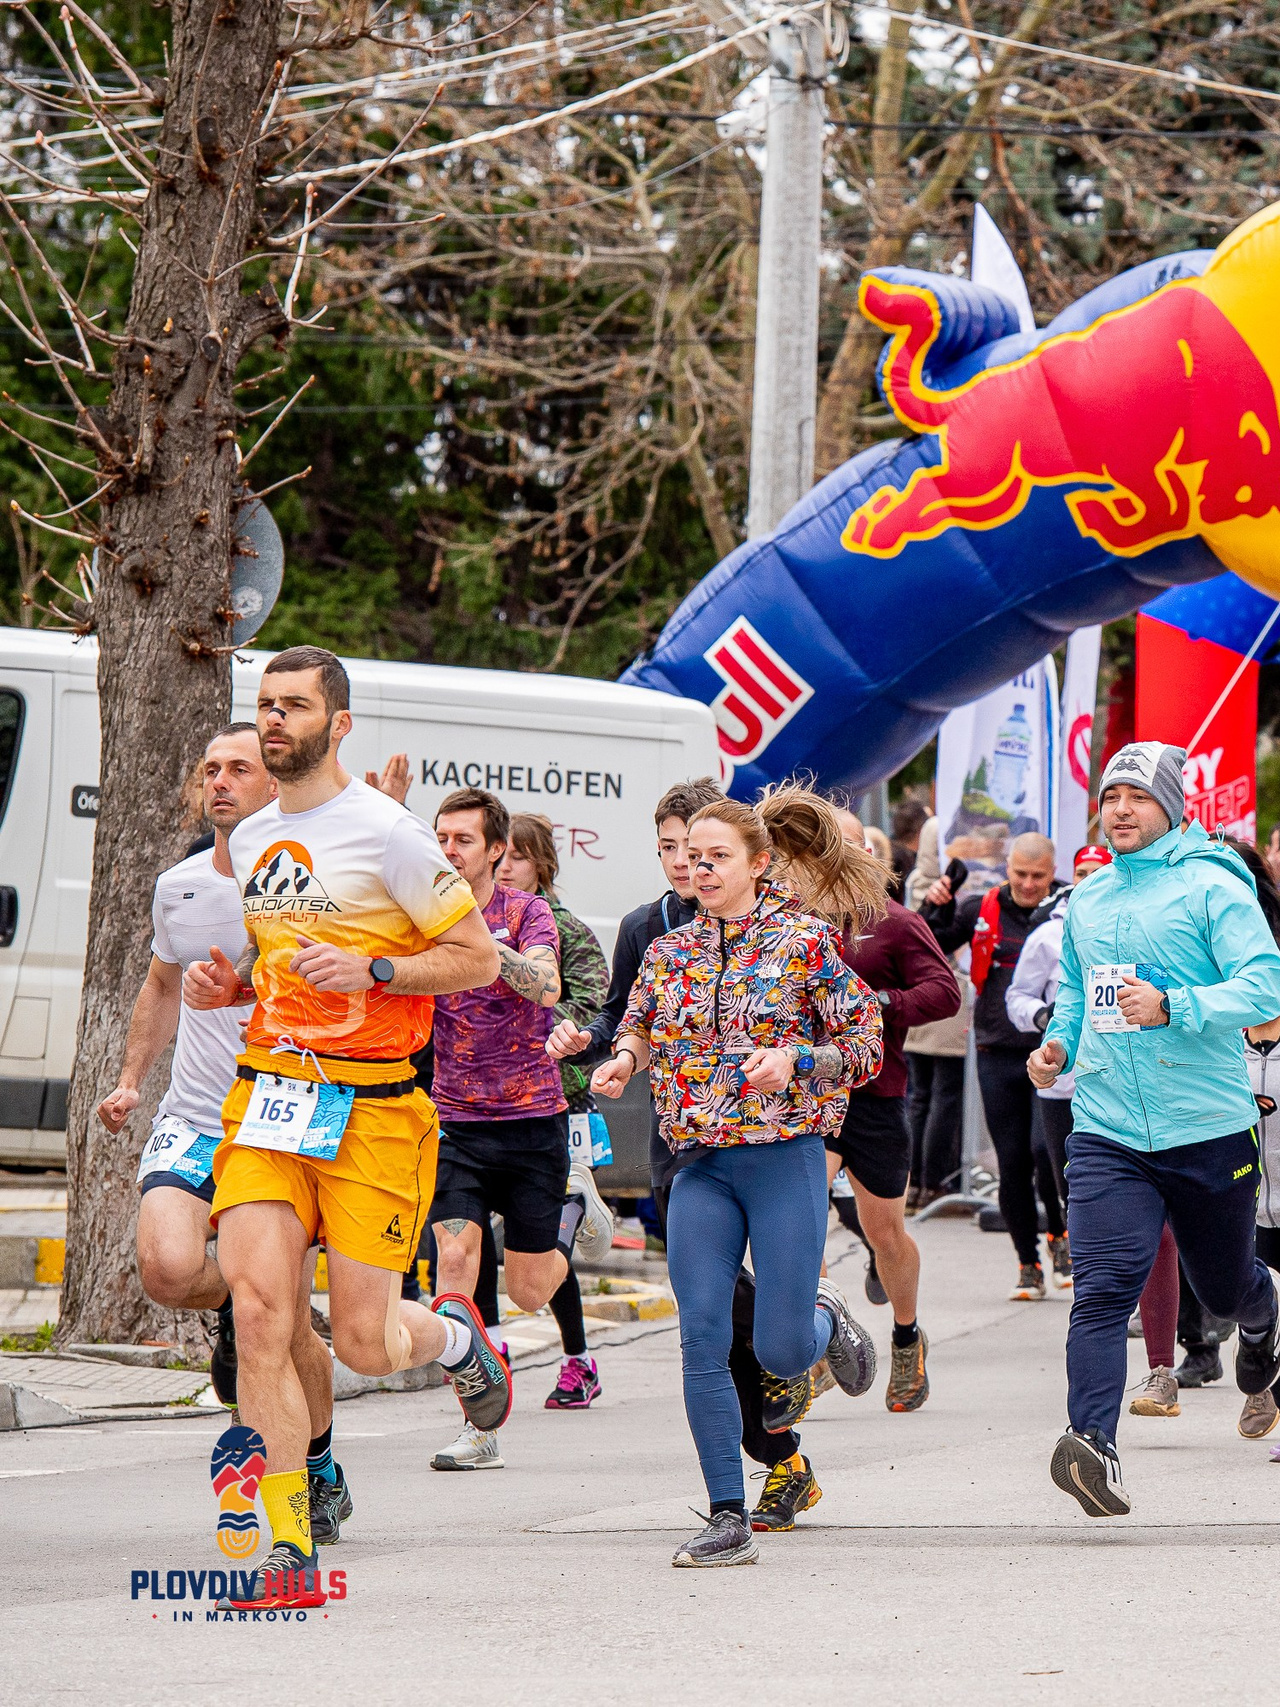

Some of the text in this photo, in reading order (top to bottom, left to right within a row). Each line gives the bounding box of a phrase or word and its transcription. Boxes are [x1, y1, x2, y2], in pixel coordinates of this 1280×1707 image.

[421, 759, 622, 799] KACHELÖFEN
[259, 1097, 299, 1123] 165
[149, 1132, 179, 1155] 105
[1232, 1163, 1253, 1181] JAKO
